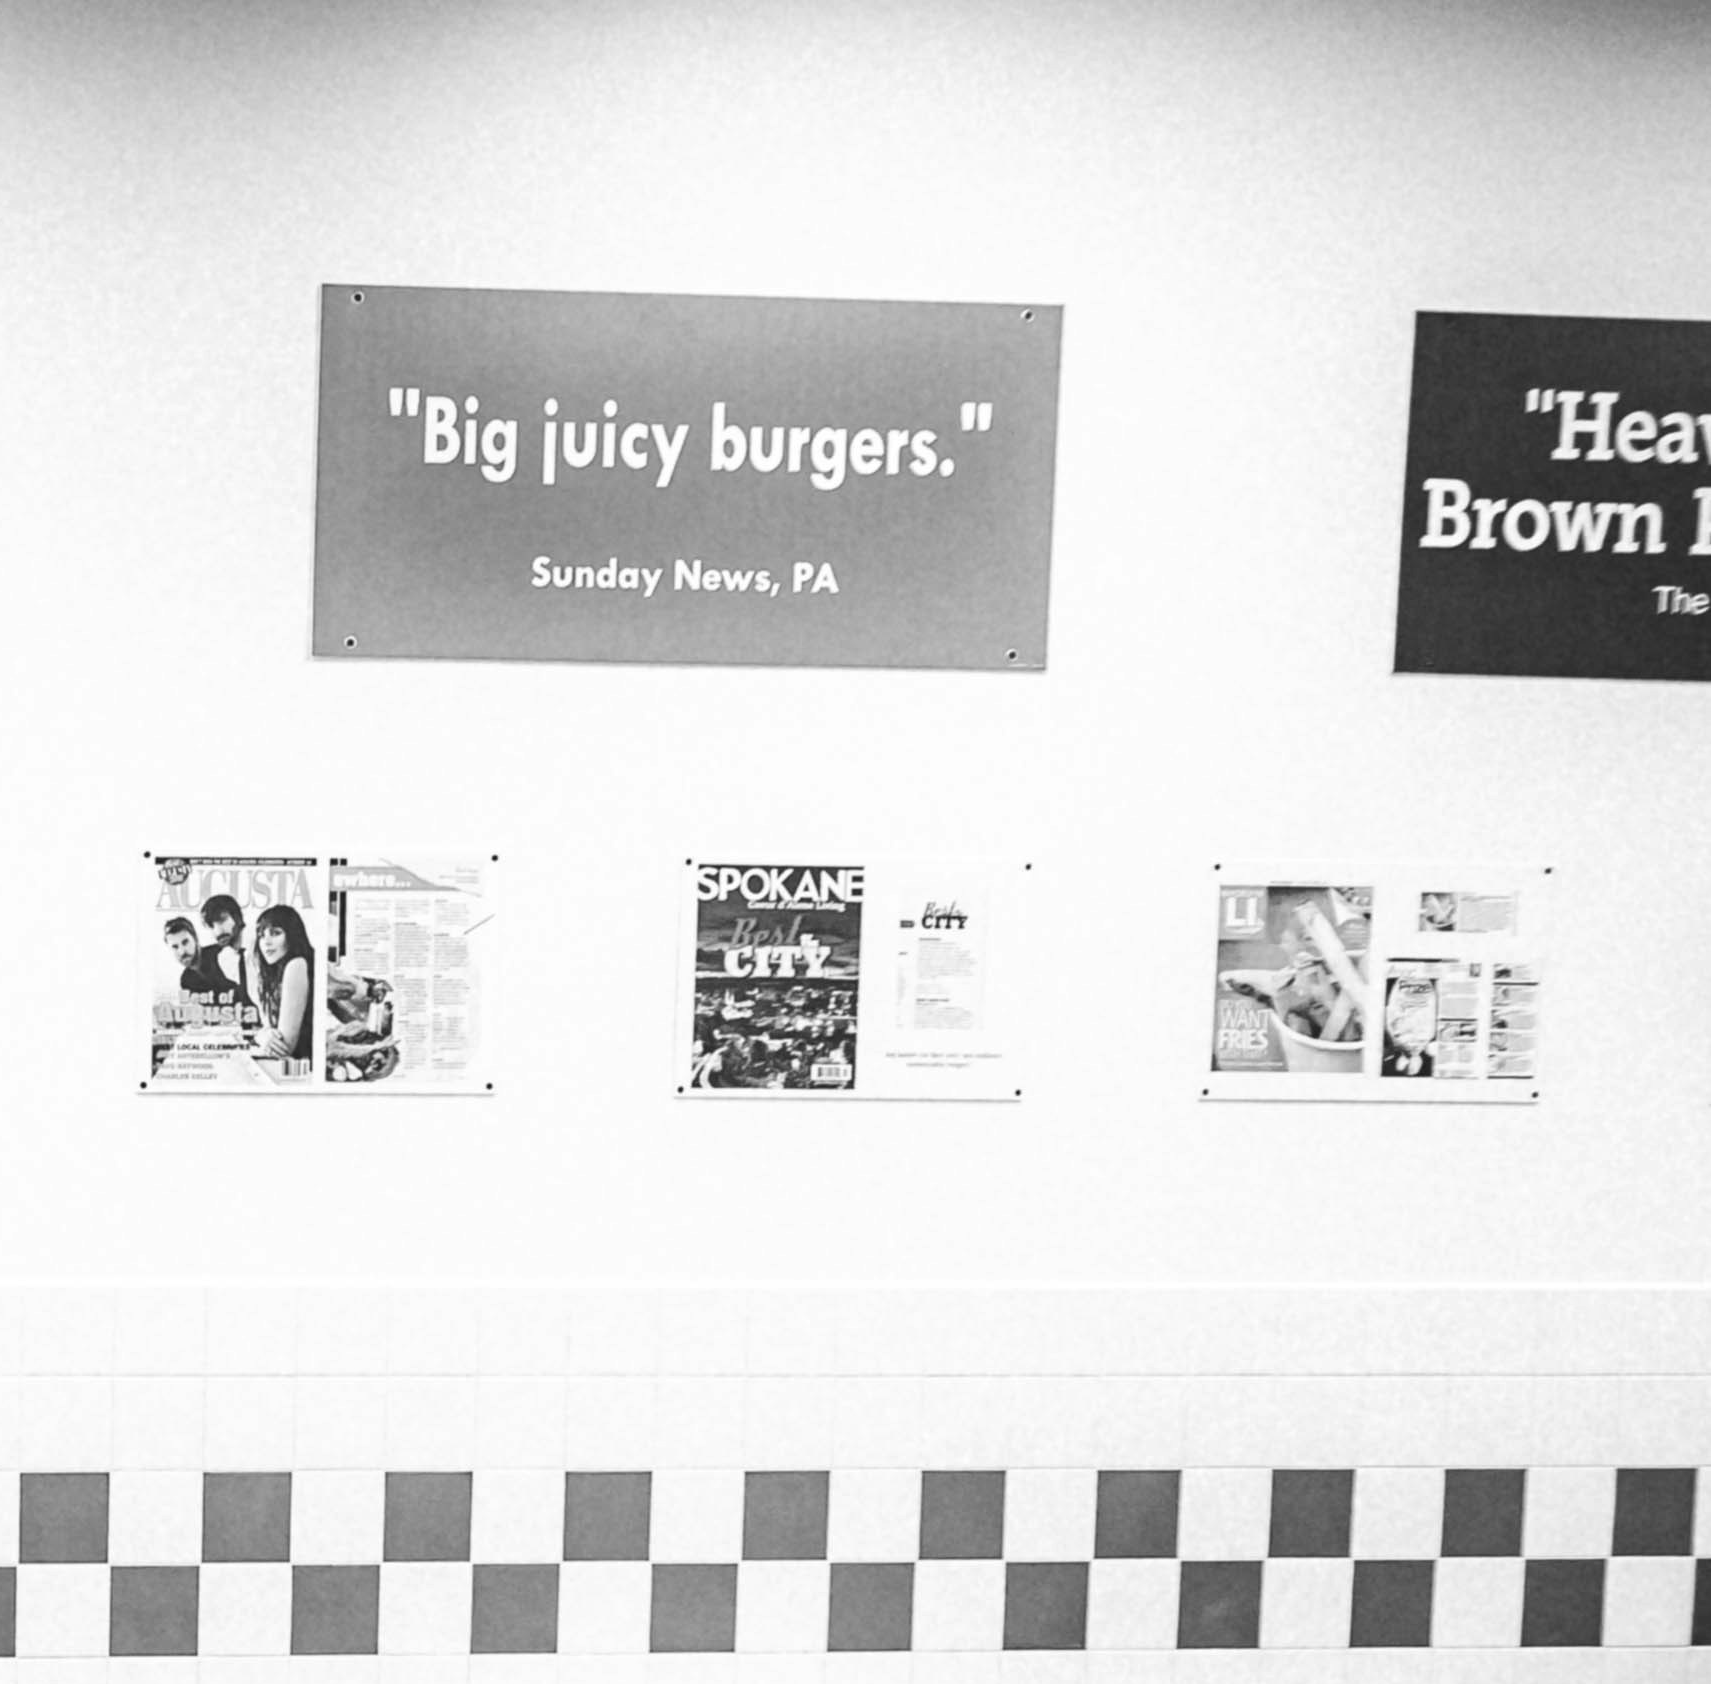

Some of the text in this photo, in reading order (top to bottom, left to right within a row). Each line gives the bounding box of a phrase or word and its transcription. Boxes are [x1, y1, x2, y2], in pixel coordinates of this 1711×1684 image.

[390, 388, 992, 490] "Big juicy burgers."
[1420, 478, 1666, 553] Brown
[532, 557, 839, 597] Sunday News, PA
[1653, 586, 1709, 614] The
[156, 869, 314, 909] AUGUSTA
[698, 867, 864, 901] SPOKANE
[730, 914, 804, 947] Best
[921, 916, 968, 929] CITY
[724, 945, 830, 978] CITY
[1218, 1030, 1268, 1049] FRIES
